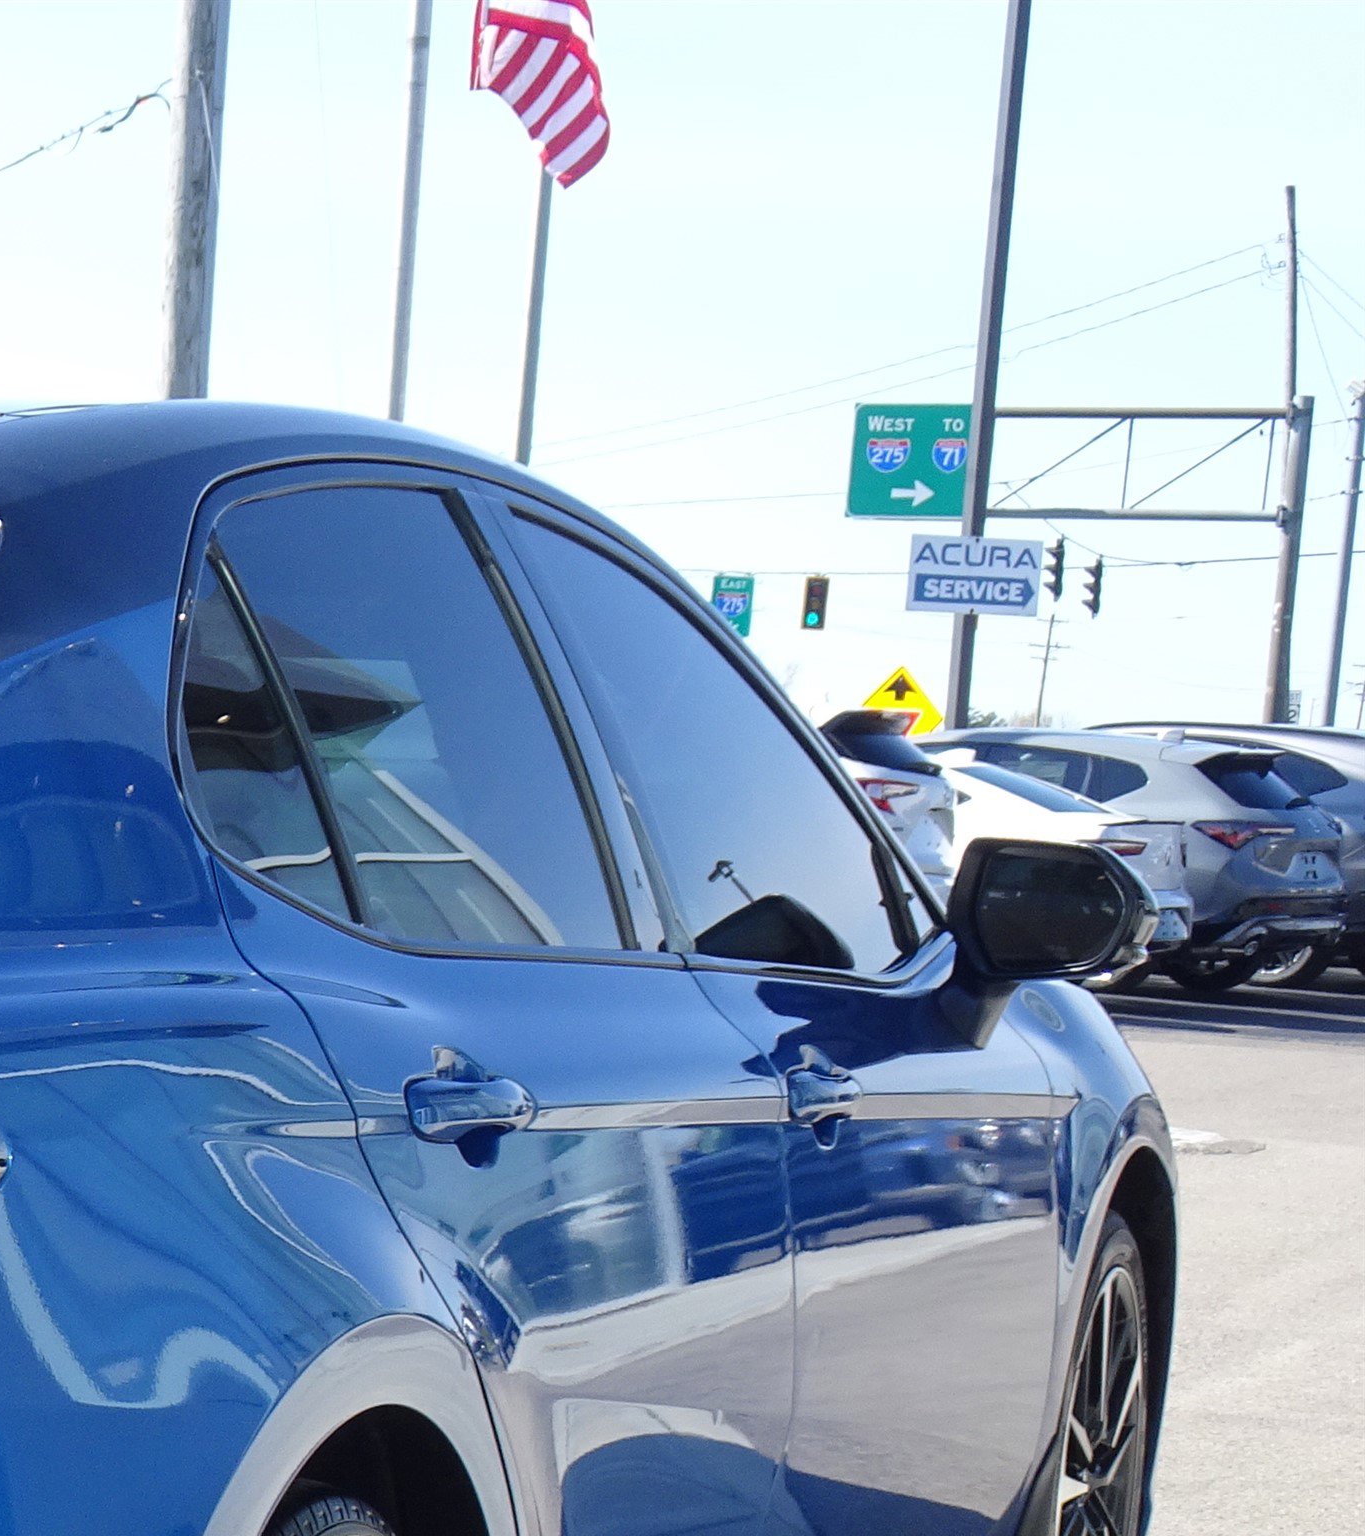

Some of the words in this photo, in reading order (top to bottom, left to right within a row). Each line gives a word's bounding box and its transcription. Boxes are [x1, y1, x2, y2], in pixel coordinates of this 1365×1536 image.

[867, 415, 915, 432] WEST
[942, 417, 965, 432] TO
[871, 447, 905, 463] 275
[940, 447, 960, 466] 71
[914, 541, 1038, 569] ACURA
[720, 579, 747, 589] EAST
[923, 578, 1024, 602] SERVICE
[722, 597, 744, 613] 275
